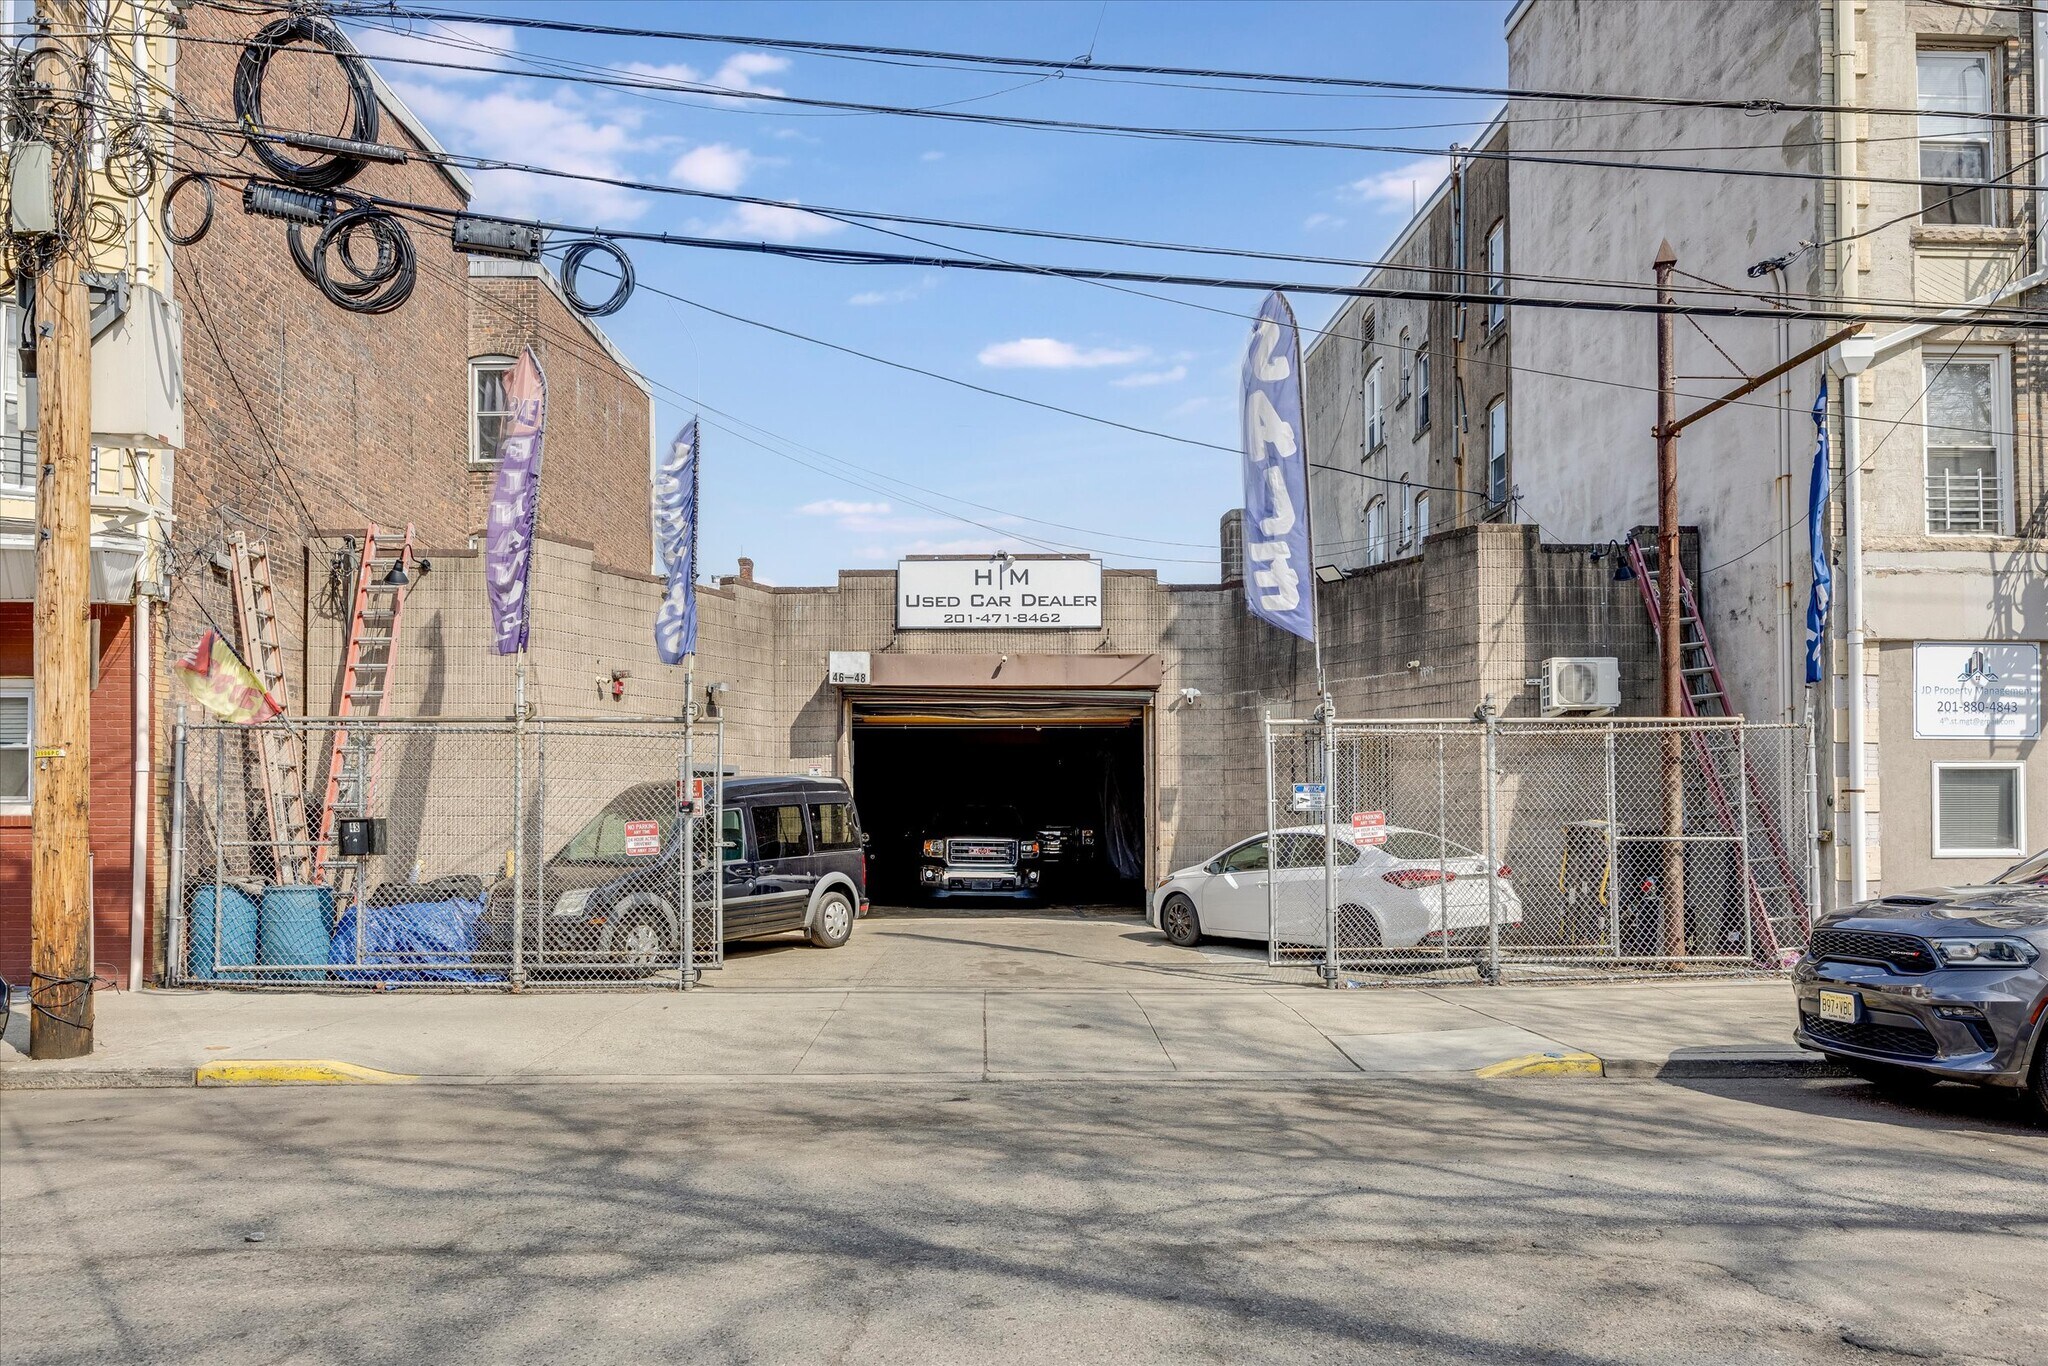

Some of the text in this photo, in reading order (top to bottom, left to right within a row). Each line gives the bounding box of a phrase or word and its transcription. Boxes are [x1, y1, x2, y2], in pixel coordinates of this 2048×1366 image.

[905, 594, 1098, 608] USED CAR DEALER
[944, 614, 1061, 624] 201-471-8462
[1921, 686, 2033, 698] JD Property Management
[1937, 701, 2018, 713] 201-880-4843
